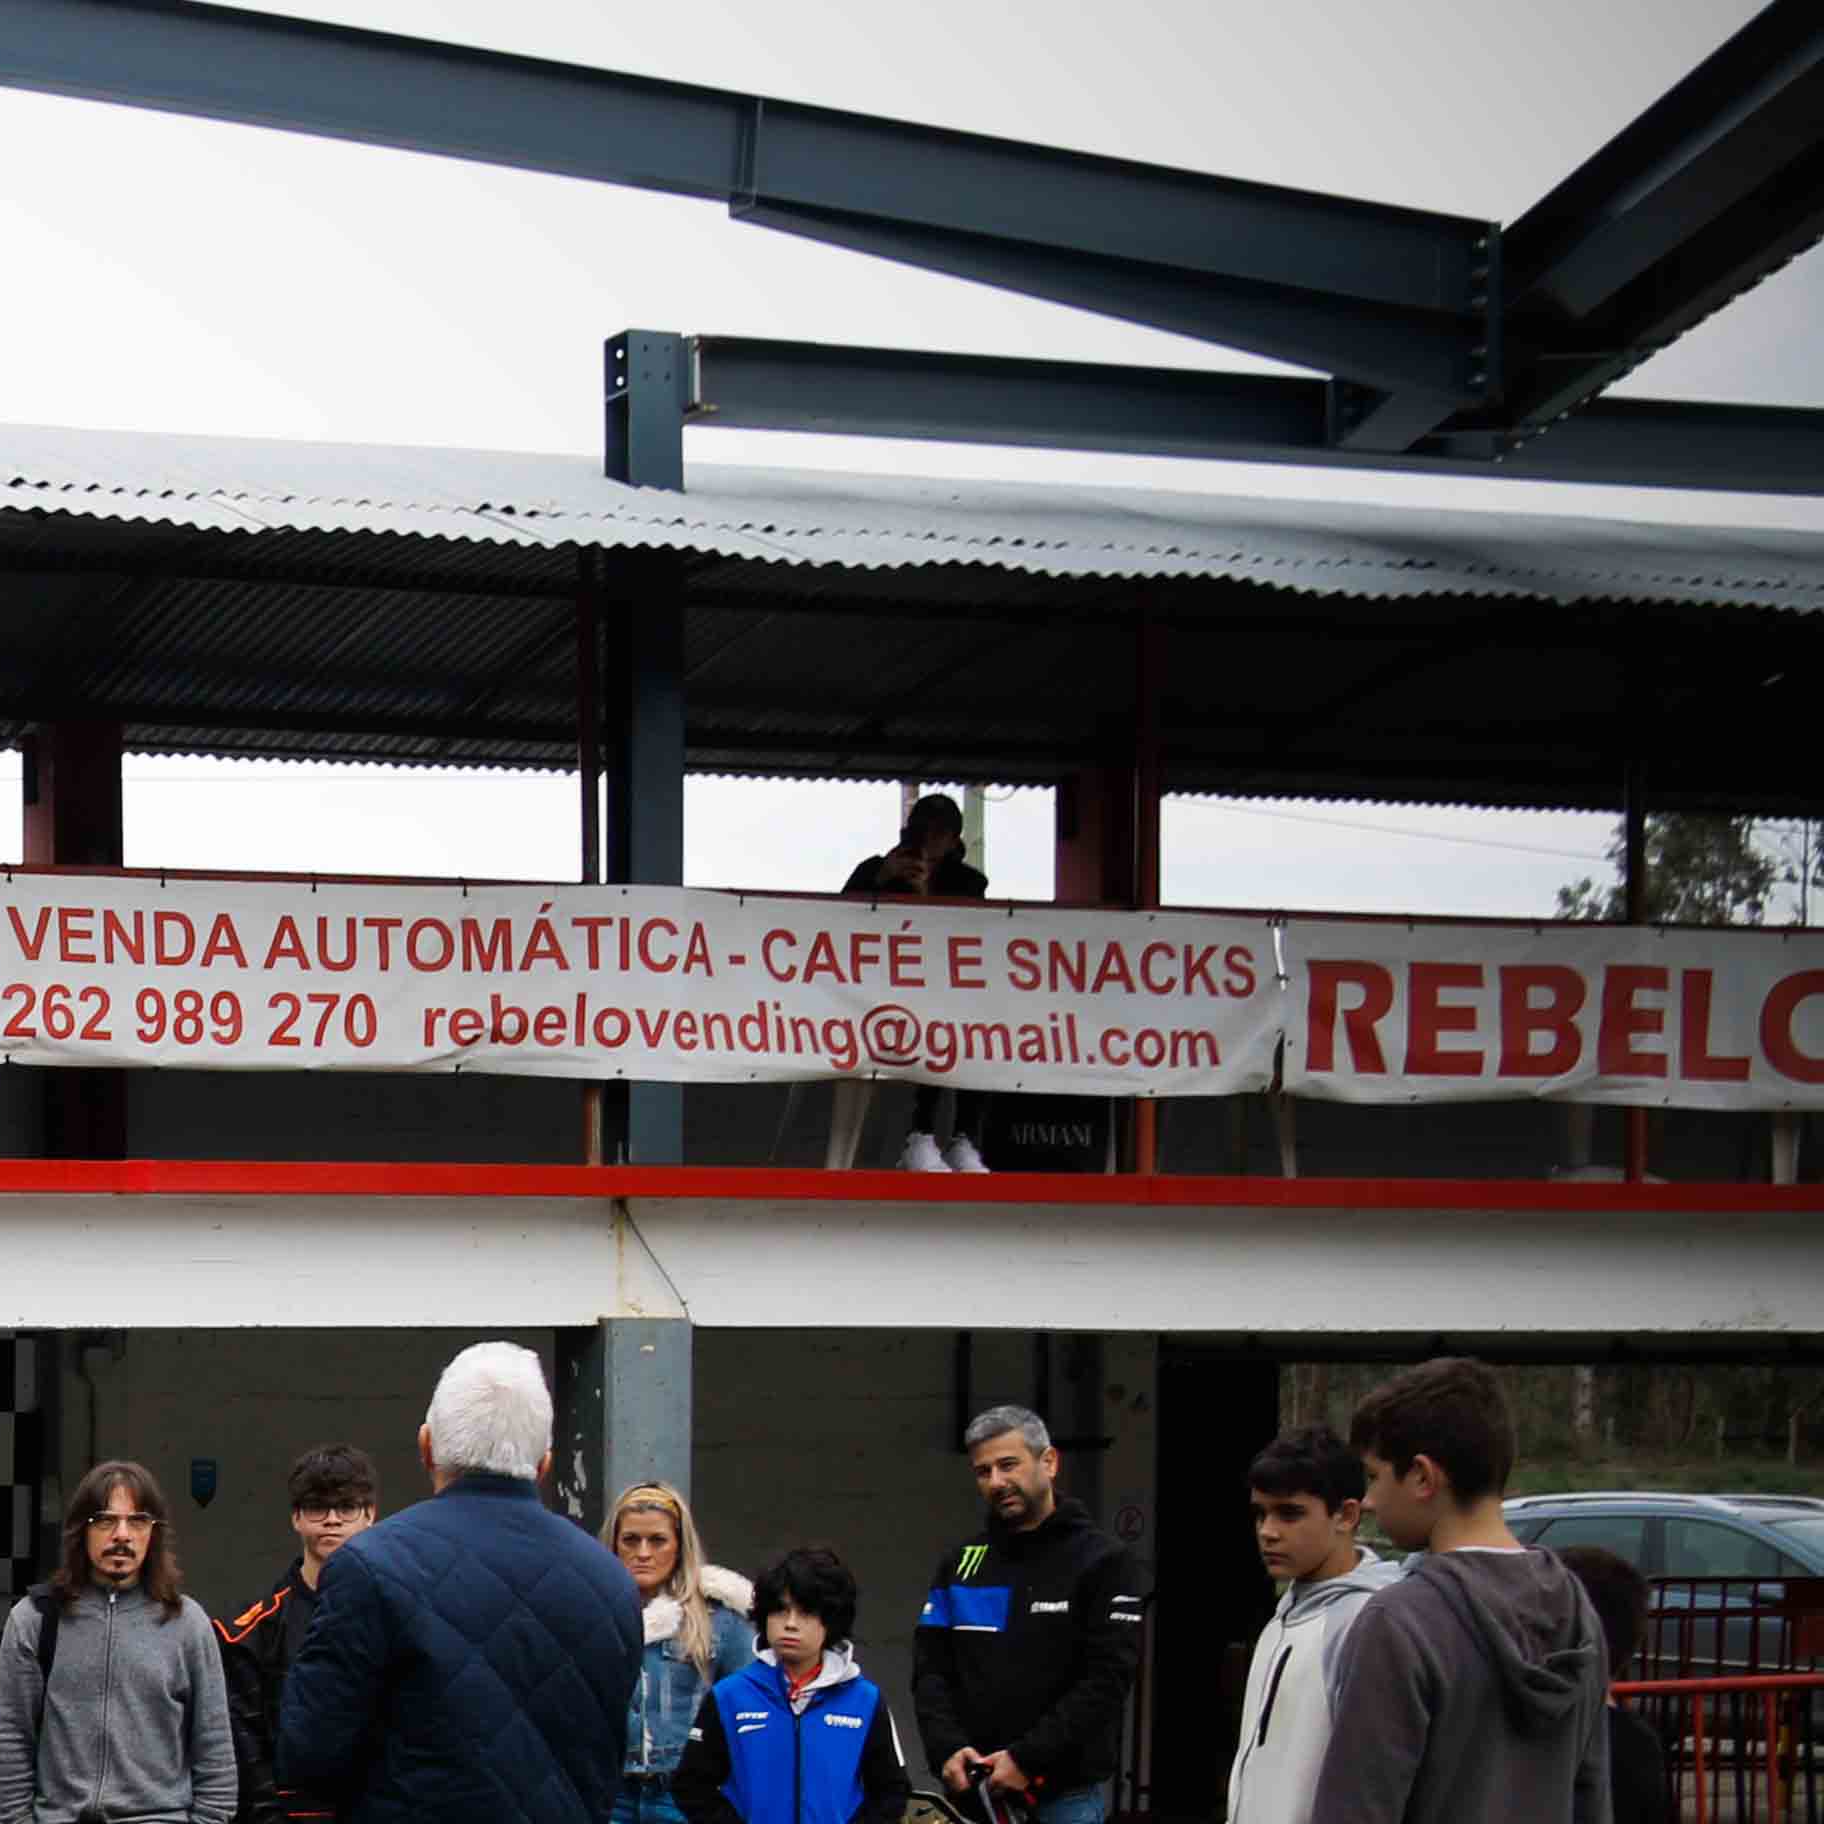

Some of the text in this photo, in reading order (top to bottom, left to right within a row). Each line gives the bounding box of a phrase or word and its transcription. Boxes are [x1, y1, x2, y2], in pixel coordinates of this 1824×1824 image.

[6, 906, 249, 969] VENDA
[263, 902, 715, 977] AUTOMÁTICA
[761, 918, 925, 989] CAFÉ
[948, 936, 984, 989] E
[1007, 938, 1256, 998] SNACKS
[1, 982, 113, 1041] 262
[135, 987, 245, 1047] 989
[267, 991, 378, 1050] 270
[422, 991, 1221, 1074] rebelovending@gmail.com
[1302, 960, 1824, 1083] REBELO
